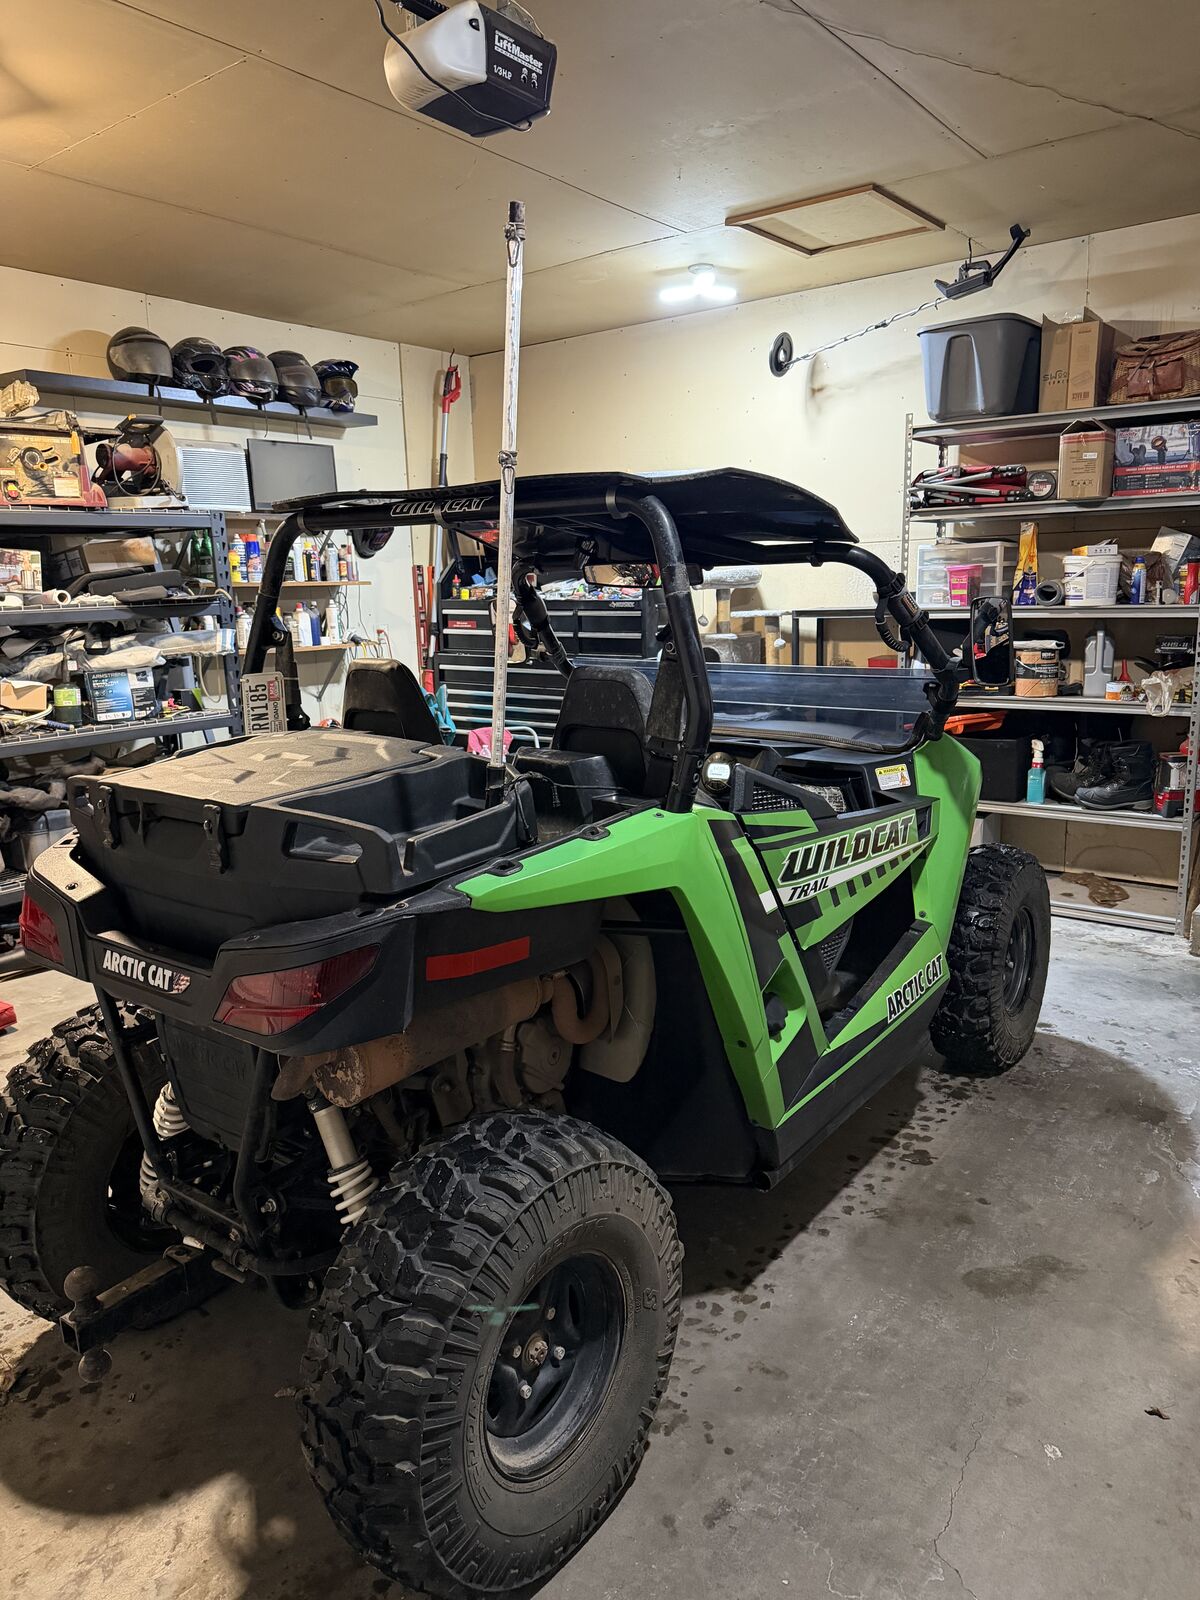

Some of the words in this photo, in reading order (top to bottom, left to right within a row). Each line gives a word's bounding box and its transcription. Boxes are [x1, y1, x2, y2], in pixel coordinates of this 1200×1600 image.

[495, 34, 542, 69] LiftMaster
[778, 813, 915, 885] WILDCAT
[788, 877, 829, 901] TRAIL
[103, 950, 146, 982] ARCTIC
[148, 965, 172, 990] CAT
[886, 970, 926, 1024] ARCTIC
[925, 952, 943, 986] CAT
